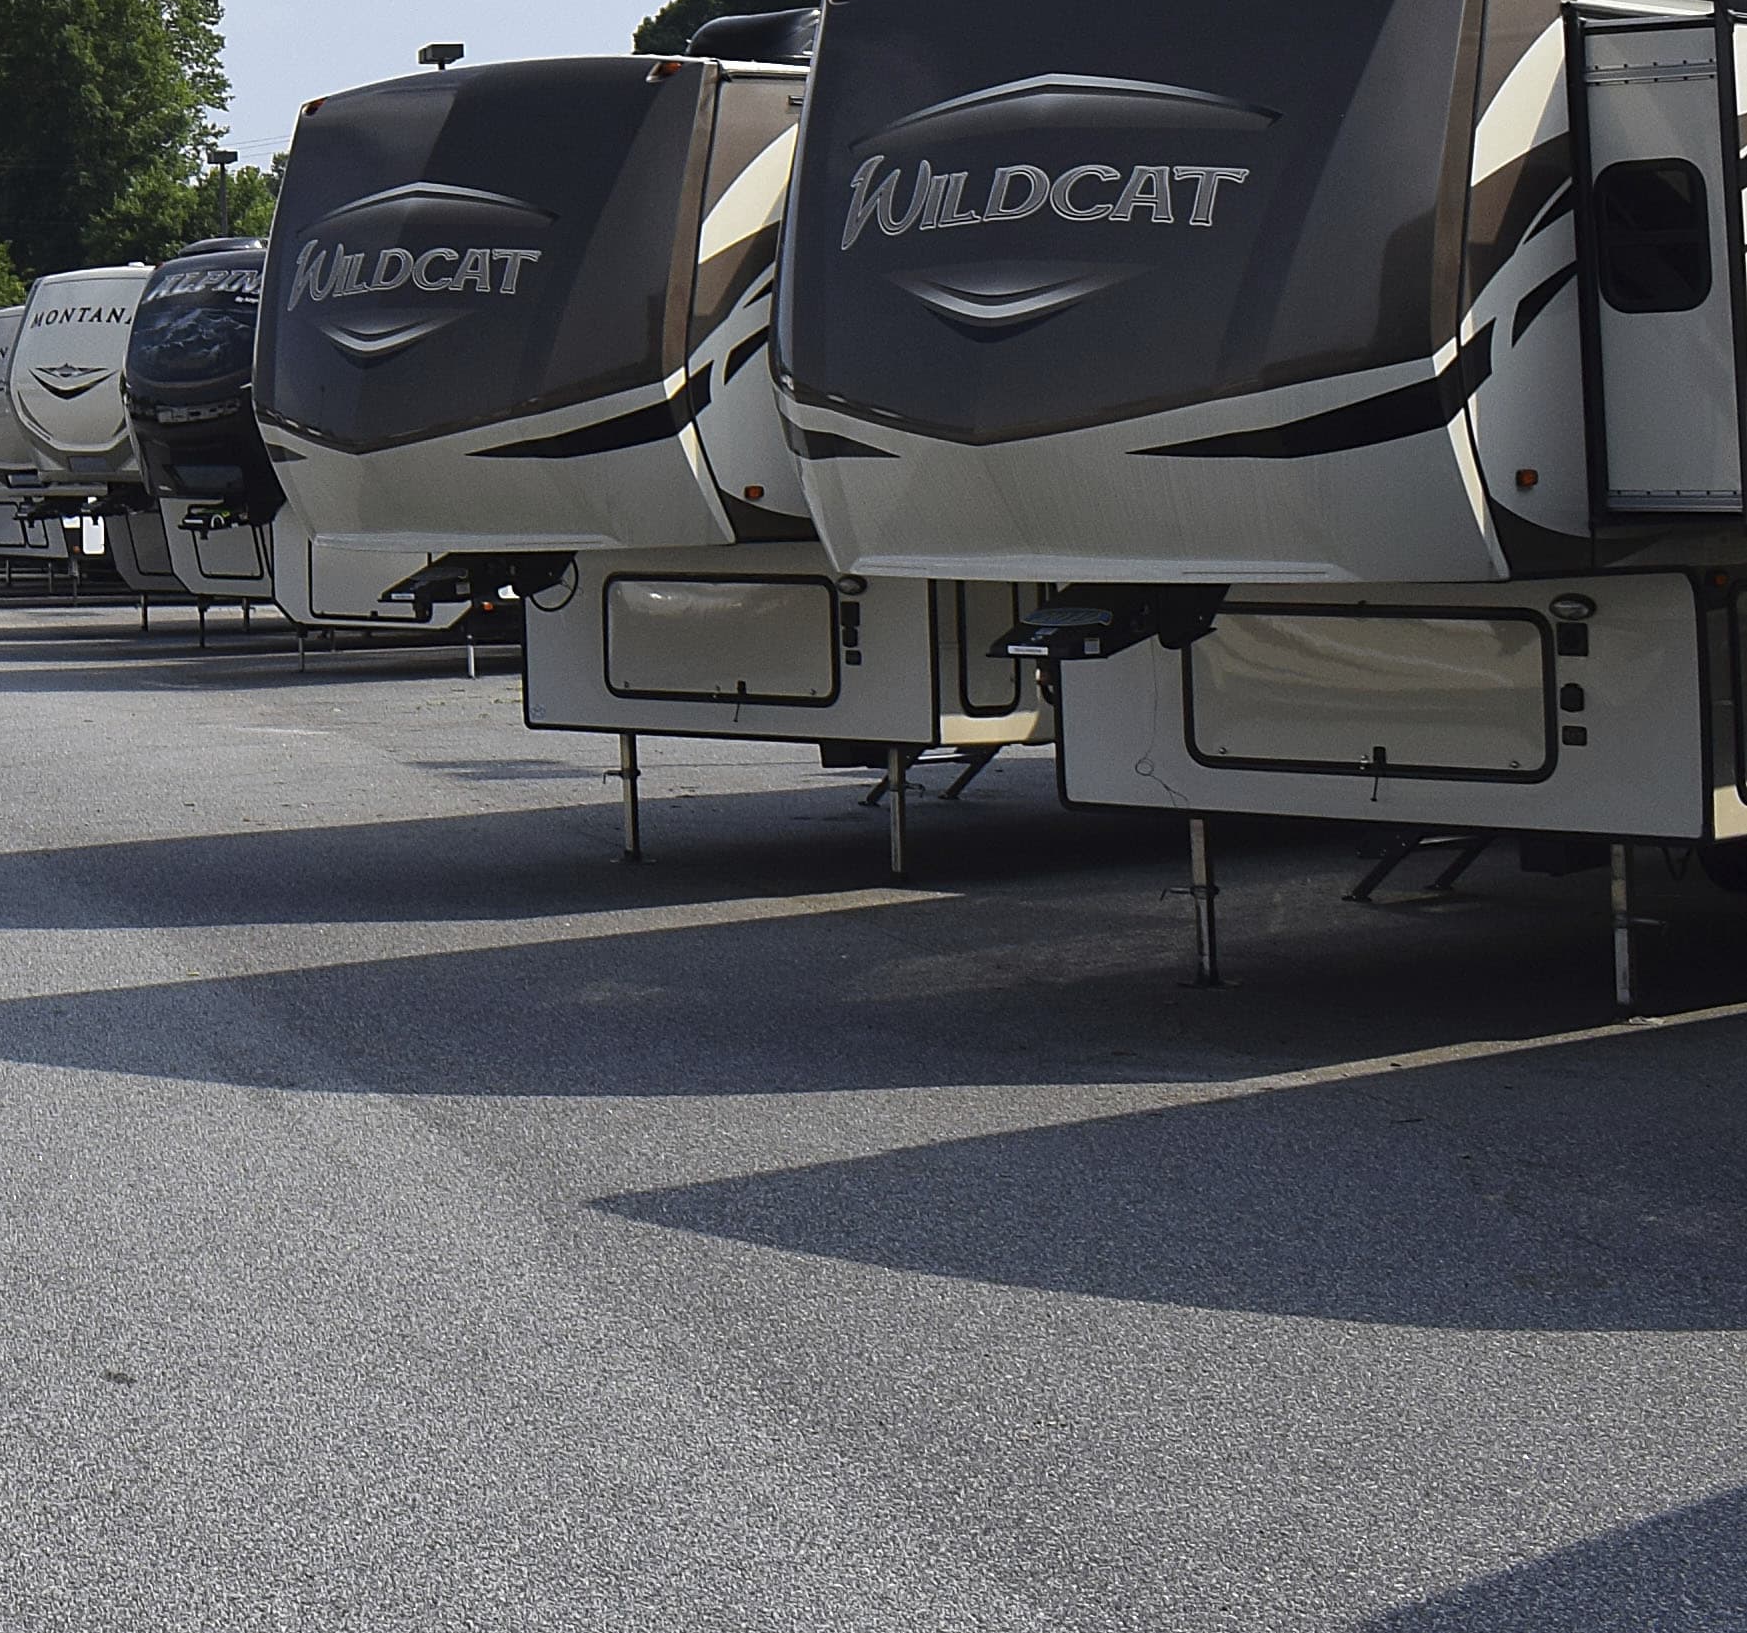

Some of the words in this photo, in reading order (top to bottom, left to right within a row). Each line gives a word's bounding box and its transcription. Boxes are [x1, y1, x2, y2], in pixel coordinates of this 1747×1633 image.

[841, 155, 1249, 250] WILDCAT
[142, 269, 263, 304] ALPIN
[287, 239, 542, 311] WILDCAT
